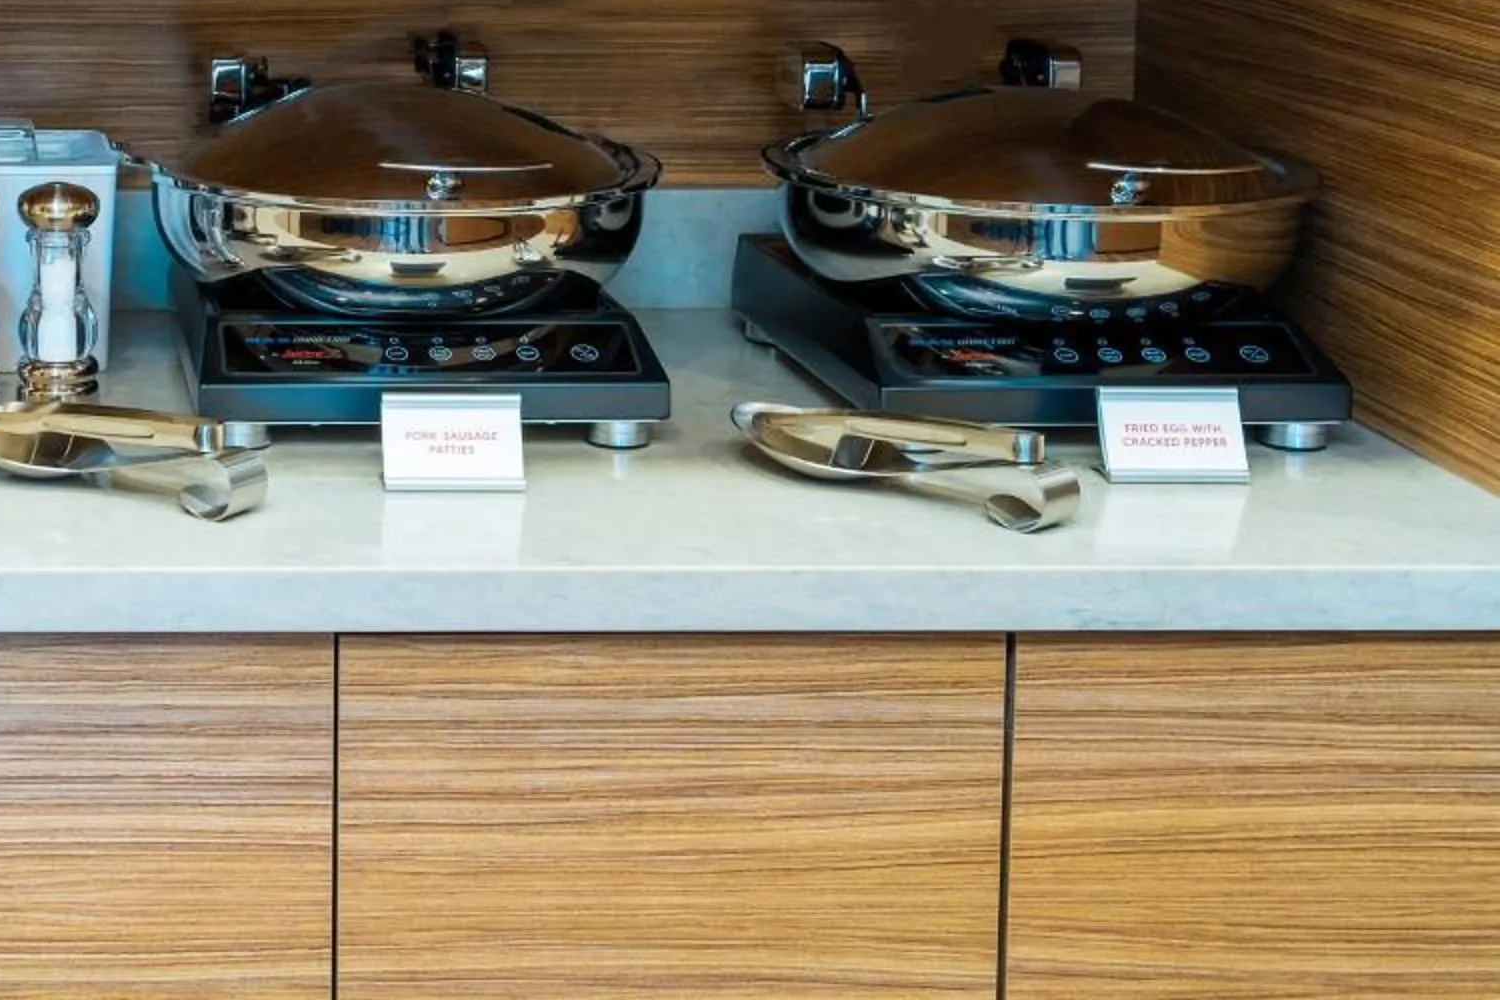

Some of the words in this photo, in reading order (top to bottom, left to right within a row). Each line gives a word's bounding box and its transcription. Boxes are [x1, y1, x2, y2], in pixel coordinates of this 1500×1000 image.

[1125, 423, 1158, 433] FRIED
[1163, 423, 1188, 433] EGG
[1192, 423, 1222, 433] WITH
[405, 431, 437, 441] PORK
[443, 431, 499, 441] SAUSAGE
[1122, 437, 1181, 447] CRACKED
[1183, 437, 1227, 447] PEPPER
[428, 444, 475, 455] PATTIES
